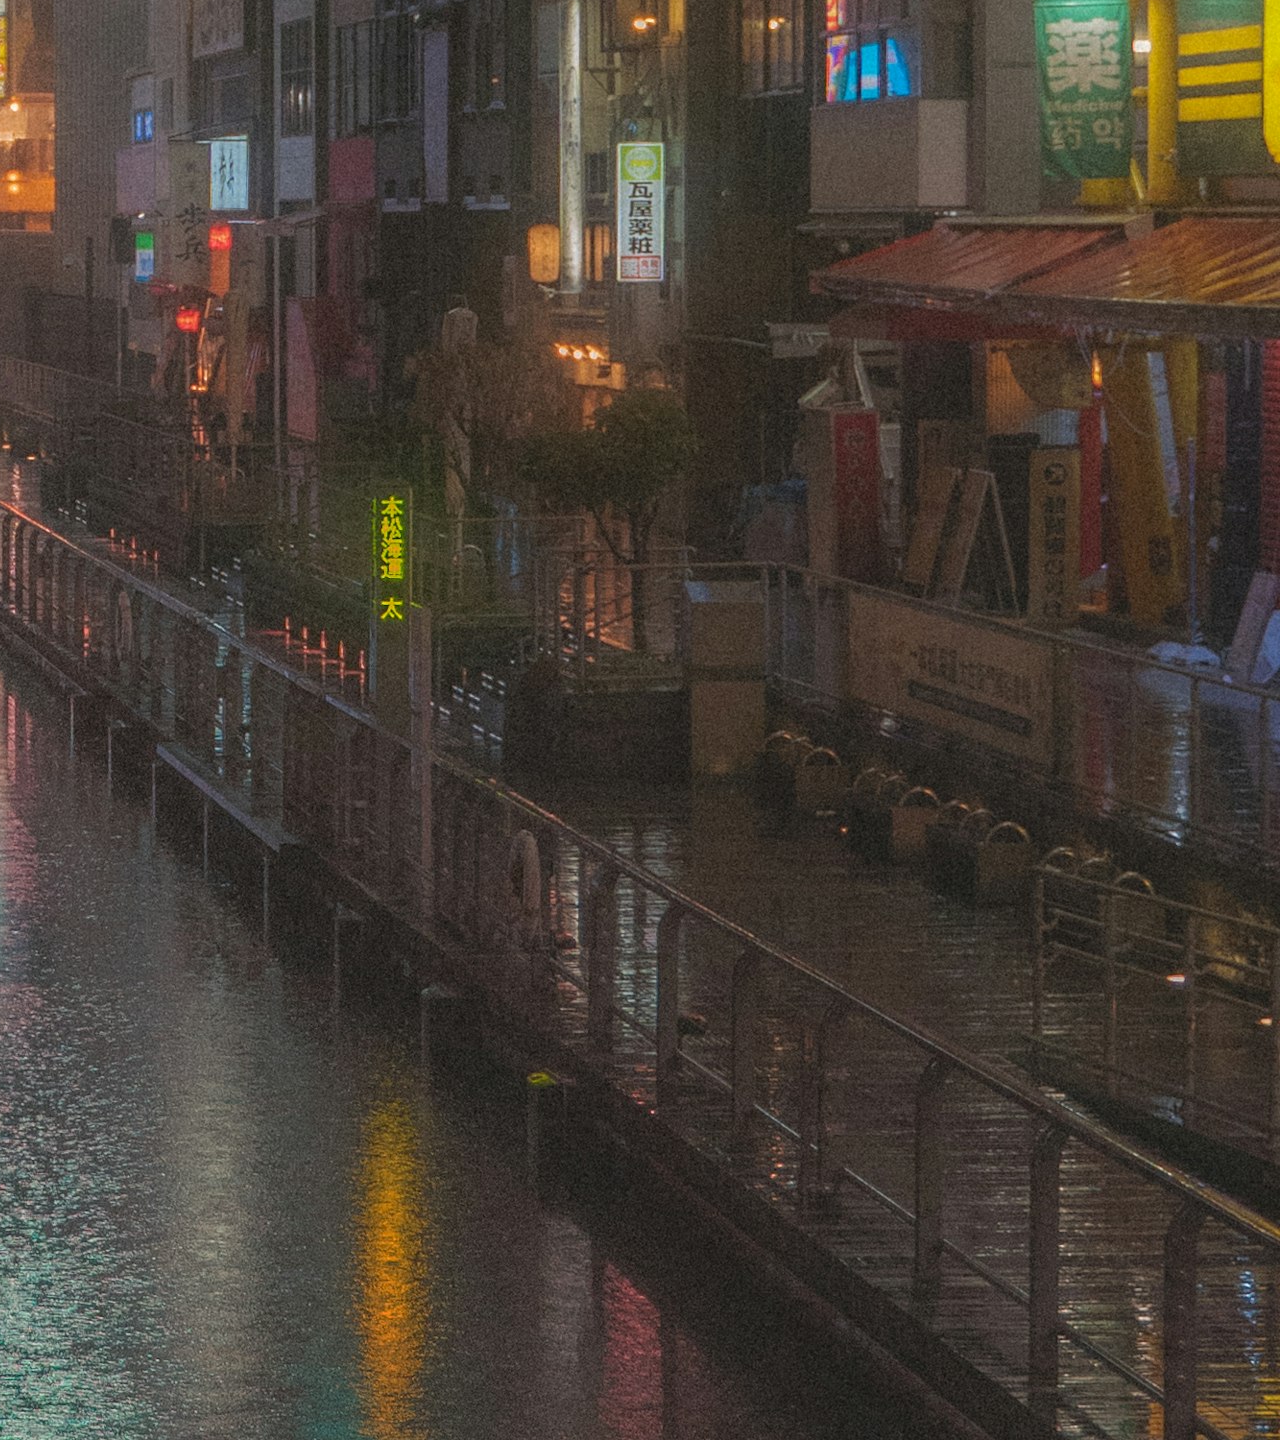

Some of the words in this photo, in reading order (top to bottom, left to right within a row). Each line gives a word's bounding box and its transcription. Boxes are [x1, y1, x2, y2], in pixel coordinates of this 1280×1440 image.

[1044, 17, 1122, 93] 薬
[628, 181, 654, 255] 瓦屋薬粧
